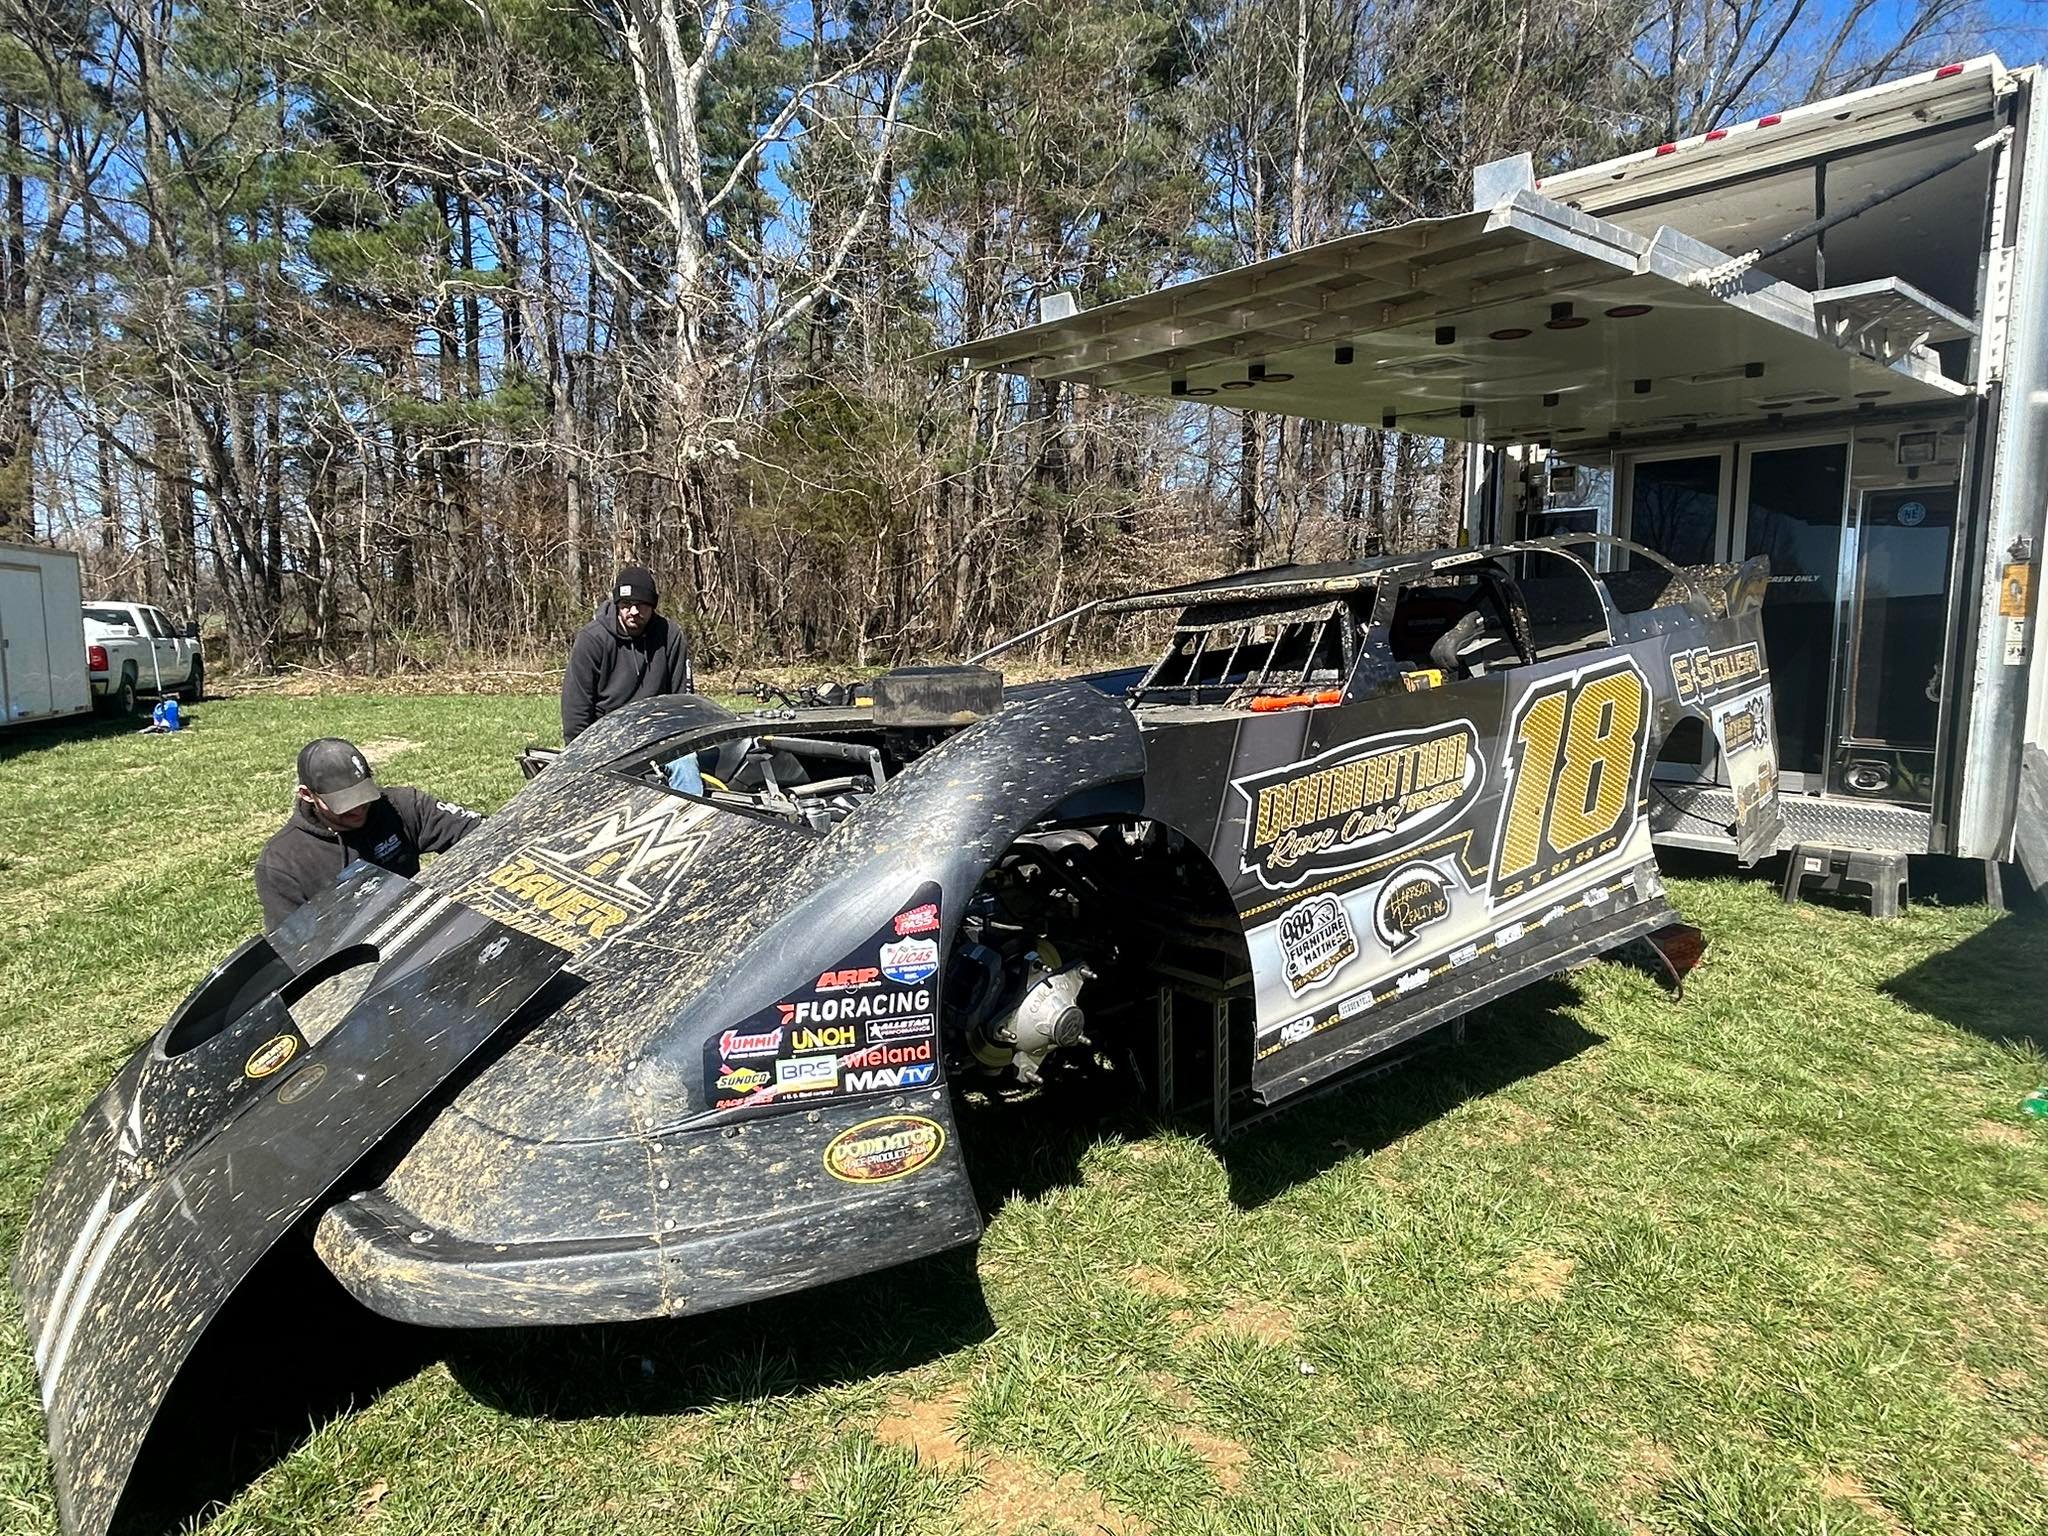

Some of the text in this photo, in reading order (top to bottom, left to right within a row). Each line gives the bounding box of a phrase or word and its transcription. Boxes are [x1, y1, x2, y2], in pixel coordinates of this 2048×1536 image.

[1794, 575, 1820, 583] ONLY
[1498, 669, 1642, 881] 18
[1254, 732, 1468, 848] DOMINATION
[1267, 828, 1337, 869] Race
[1340, 797, 1406, 843] Cars
[488, 858, 627, 940] BAUER
[1283, 909, 1314, 948] 989
[1290, 918, 1345, 961] FURNITURE
[889, 950, 933, 966] LUCAS
[1304, 929, 1348, 965] MATTRESS
[816, 967, 879, 987] ARP
[795, 989, 930, 1023] FLORACING
[791, 1025, 856, 1050] UNOH
[1280, 1015, 1315, 1041] MSD
[846, 1040, 931, 1068] wieland
[720, 1072, 768, 1087] SUNOCO
[782, 1061, 832, 1080] BRS
[845, 1064, 935, 1091] MAVTV
